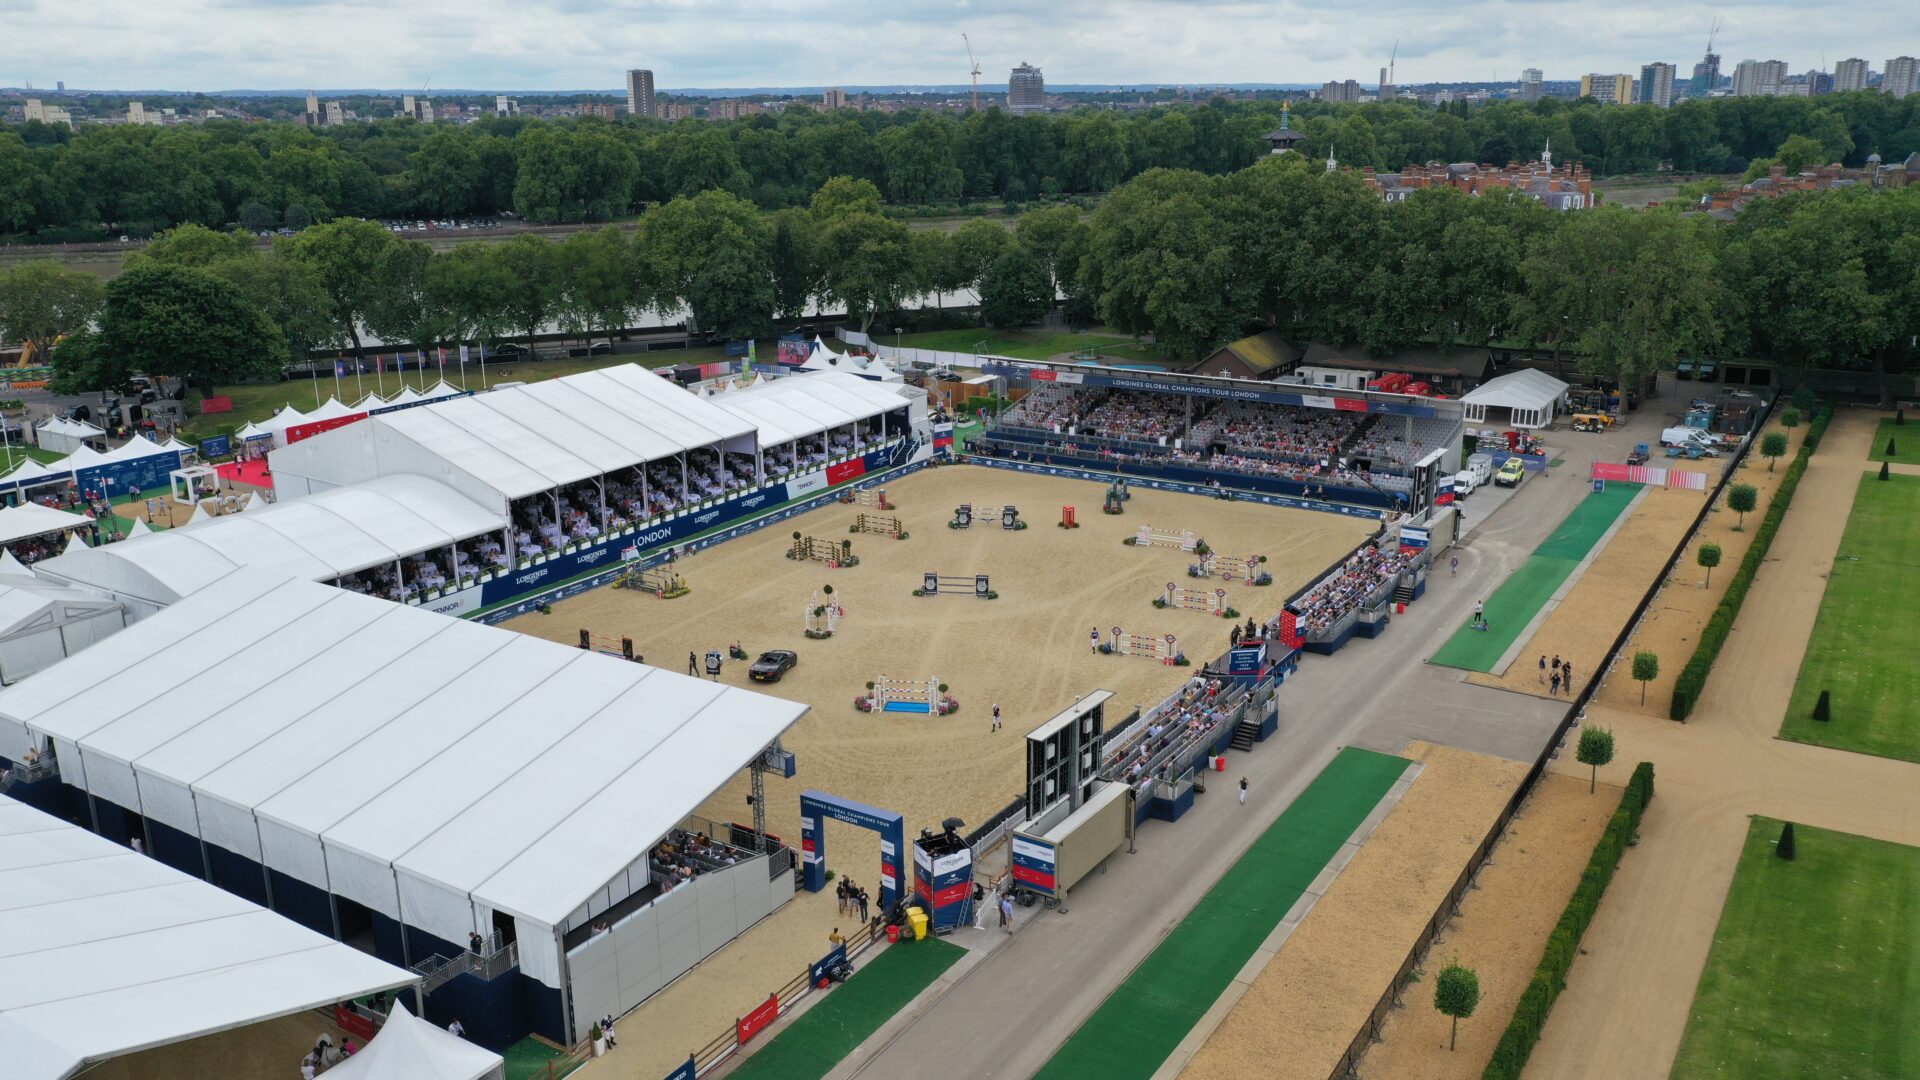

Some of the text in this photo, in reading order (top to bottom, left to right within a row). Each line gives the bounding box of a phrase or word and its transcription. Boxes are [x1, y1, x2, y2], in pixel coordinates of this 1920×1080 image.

[1112, 380, 1260, 400] LONGINES GLOBAL CHAMPIONS TOUR LONDON
[797, 480, 813, 490] TENNOR
[742, 494, 766, 508] LONGINES
[694, 510, 720, 524] LONGINES
[632, 526, 672, 548] LONDON
[576, 548, 607, 564] LONGINES
[516, 568, 548, 584] LONGINES
[803, 799, 826, 809] LONGINES
[828, 806, 846, 815] GLOBAL
[847, 811, 876, 824] CHAMPIONS
[834, 813, 858, 824] LONDON
